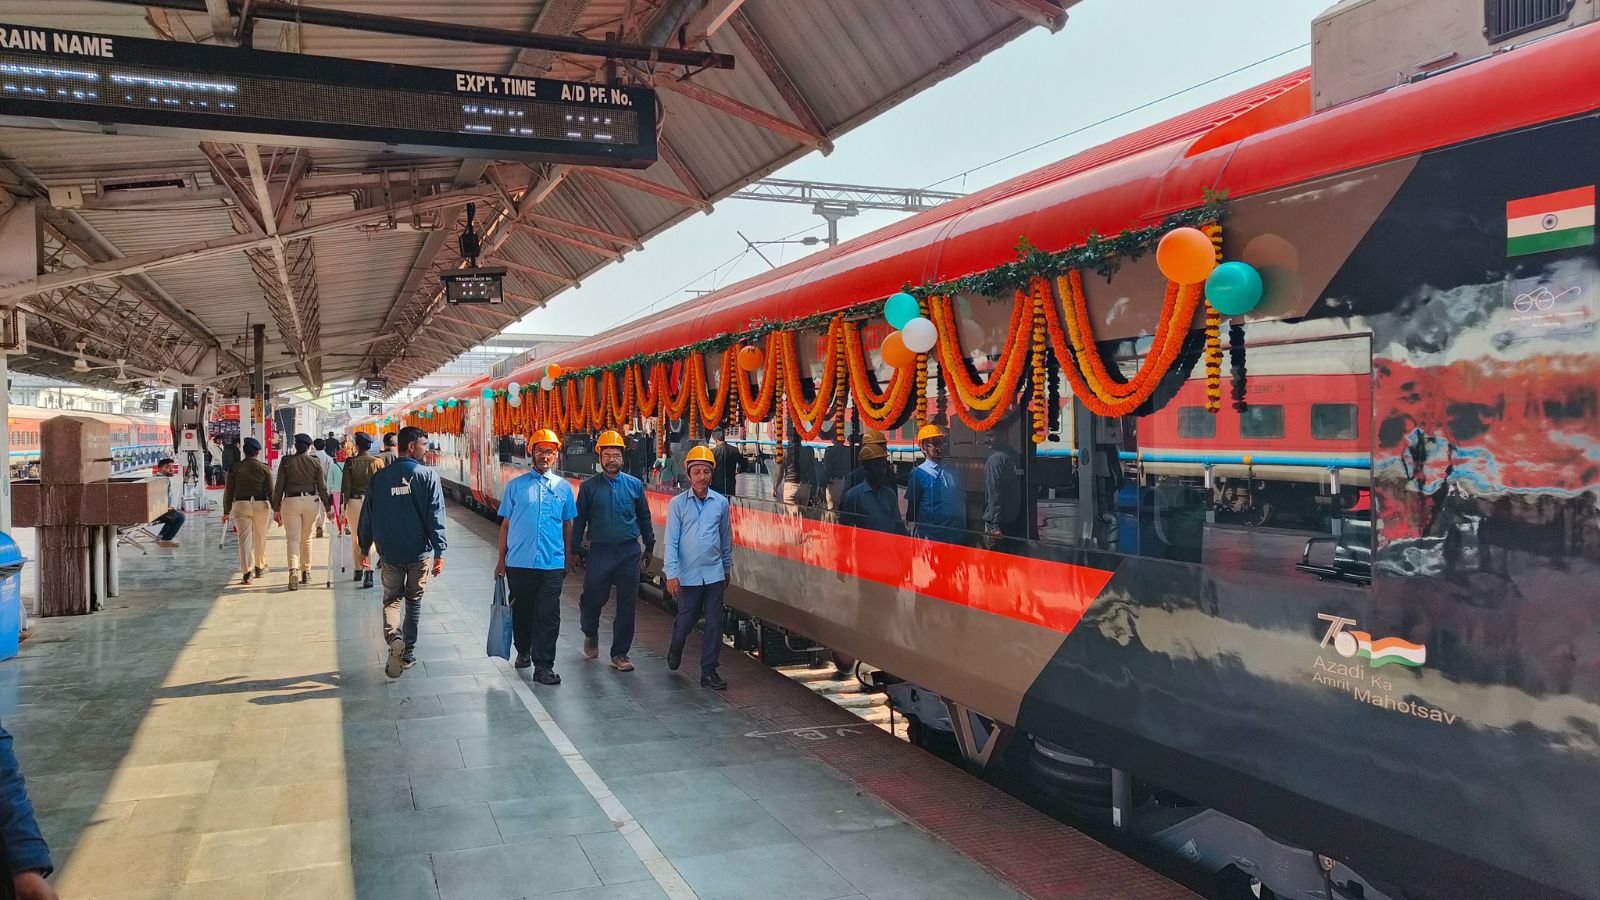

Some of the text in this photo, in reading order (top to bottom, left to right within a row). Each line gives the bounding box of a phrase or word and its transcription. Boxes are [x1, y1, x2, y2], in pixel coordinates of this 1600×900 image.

[53, 33, 114, 58] NAME
[456, 74, 536, 97] EXPT. TIME
[561, 84, 632, 106] A/D PF. No.
[372, 404, 380, 414] 2
[1312, 655, 1392, 691] Azadi Ka
[1312, 672, 1456, 725] Amrit Mahotsav
